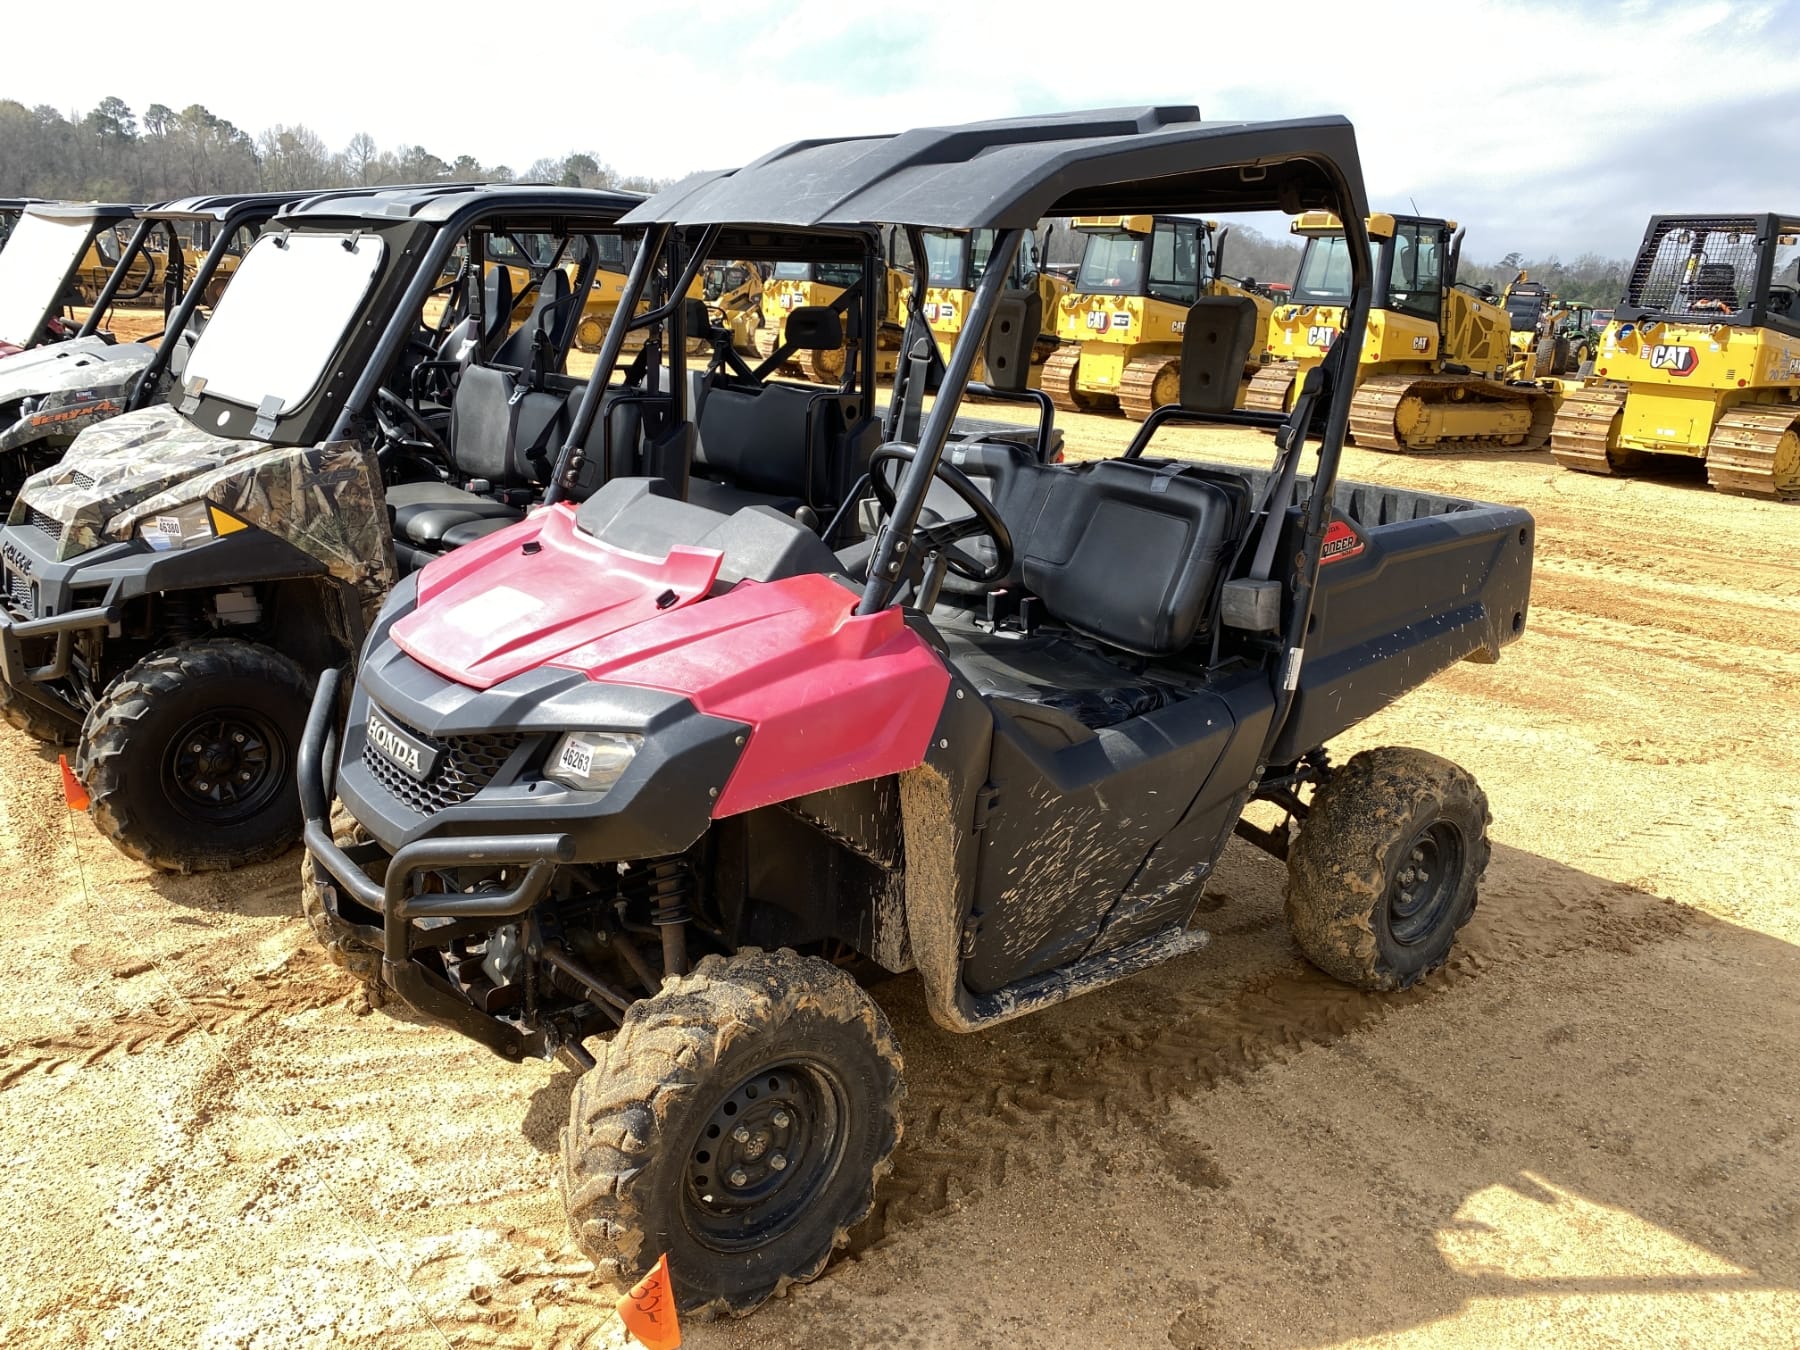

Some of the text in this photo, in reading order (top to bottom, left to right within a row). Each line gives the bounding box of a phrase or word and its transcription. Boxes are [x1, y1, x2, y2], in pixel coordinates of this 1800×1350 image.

[1087, 311, 1106, 329] CAT
[1171, 321, 1185, 333] CAT
[1308, 327, 1333, 345] CAT
[1413, 336, 1428, 350] CAT
[1651, 346, 1690, 369] CAT
[159, 522, 180, 534] 46380
[367, 715, 421, 773] HONDA
[562, 747, 590, 772] 46263
